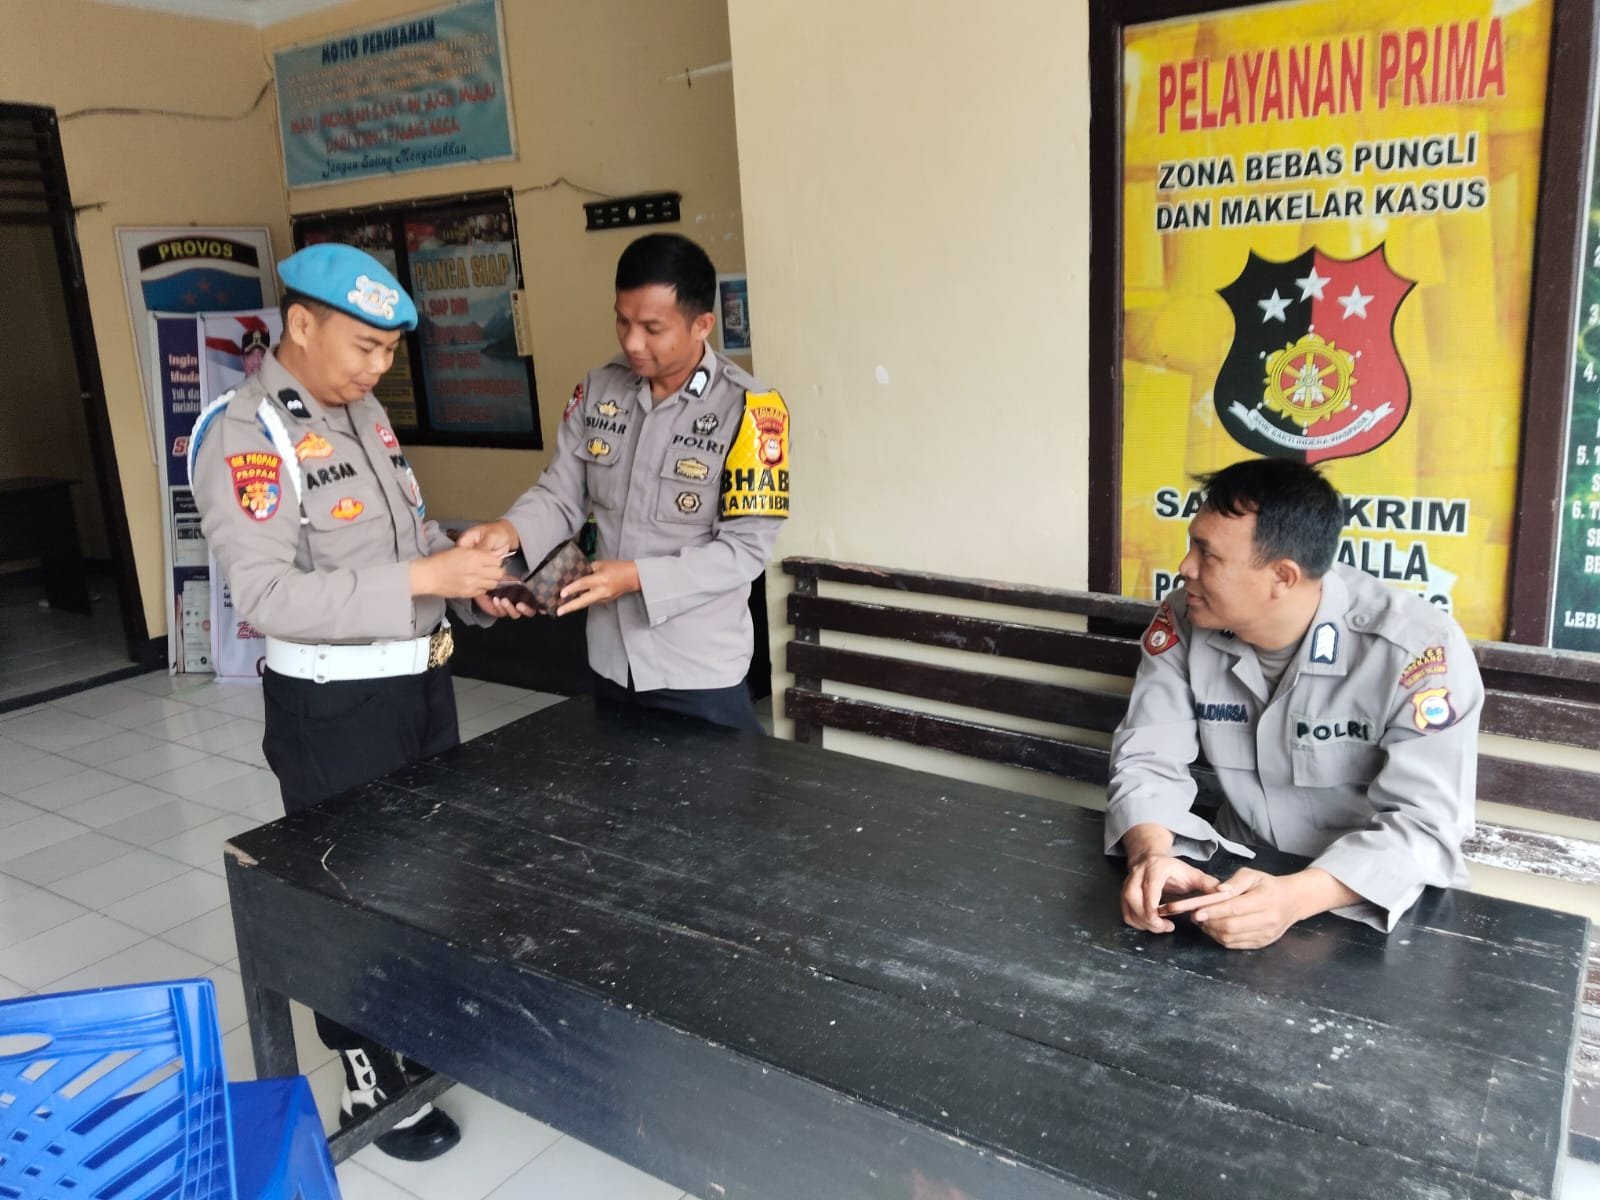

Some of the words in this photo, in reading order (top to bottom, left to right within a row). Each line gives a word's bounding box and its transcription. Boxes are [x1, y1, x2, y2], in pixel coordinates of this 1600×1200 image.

[1158, 37, 1366, 134] PELAYANAN
[1378, 17, 1505, 110] PRIMA
[1158, 158, 1235, 190] ZONA
[1245, 148, 1343, 182] BEBAS
[1354, 133, 1477, 173] PUNGLI
[1156, 204, 1210, 231] DAN
[1221, 191, 1362, 226] MAKELAR
[1375, 181, 1487, 214] KASUS
[158, 240, 233, 260] PROVOS
[414, 256, 469, 291] PANCA
[470, 253, 509, 288] SIAP
[168, 353, 198, 368] Ingin
[585, 416, 627, 435] SUHAR
[673, 434, 725, 455] POLRI
[720, 468, 789, 493] BHAB
[1156, 490, 1204, 517] SA
[1341, 498, 1467, 533] KRIM
[1296, 720, 1369, 741] POLRI
